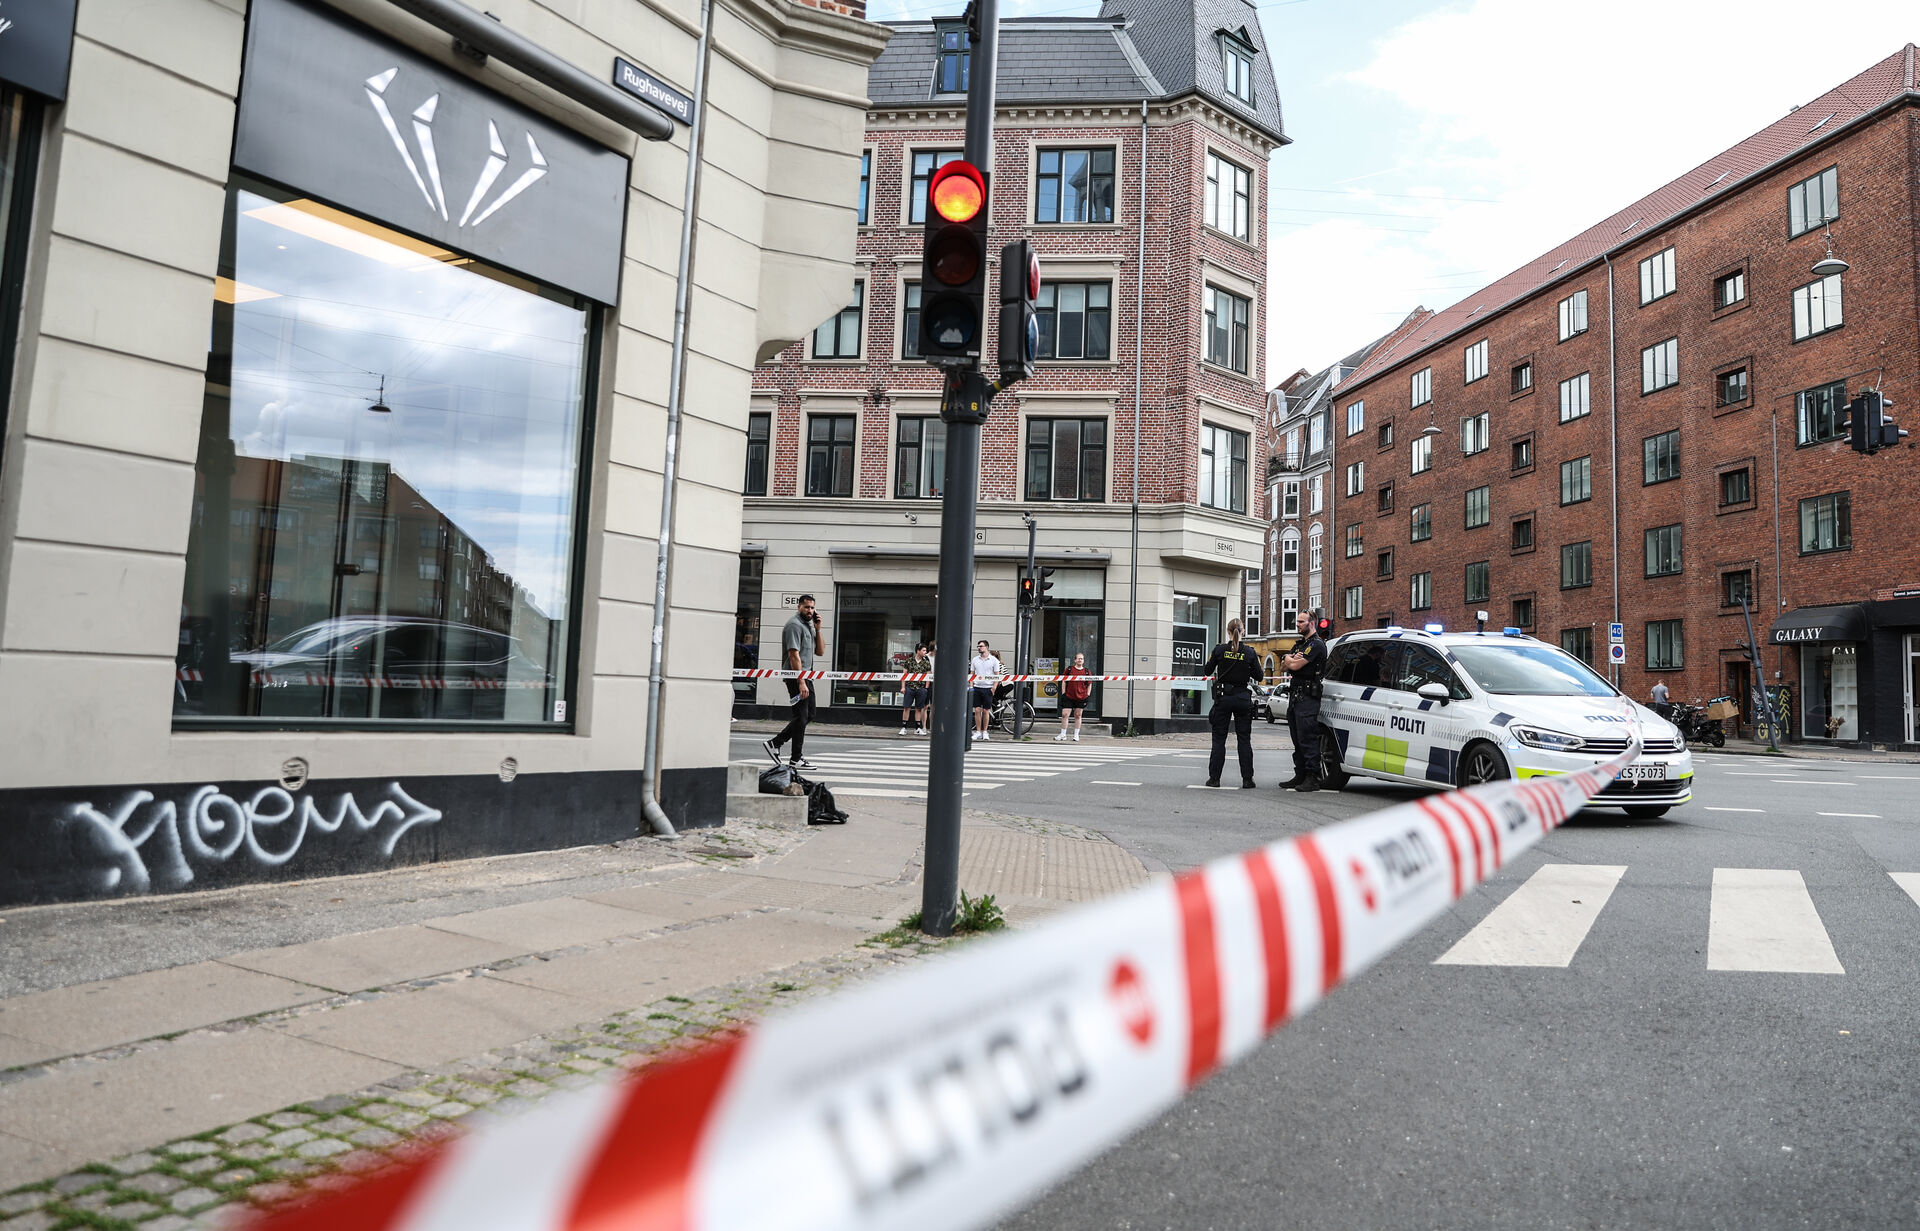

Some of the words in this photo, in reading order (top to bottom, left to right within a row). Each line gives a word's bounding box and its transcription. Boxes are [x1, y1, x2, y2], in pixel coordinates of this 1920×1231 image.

[624, 66, 688, 117] Rughavevej
[971, 402, 978, 411] 6
[1217, 542, 1232, 551] SENG
[1776, 628, 1823, 641] GALAXY
[1175, 647, 1201, 660] SENG
[1391, 715, 1425, 735] POLITI
[1583, 715, 1644, 724] POLI
[1621, 768, 1633, 778] CS
[1648, 768, 1664, 778] 073
